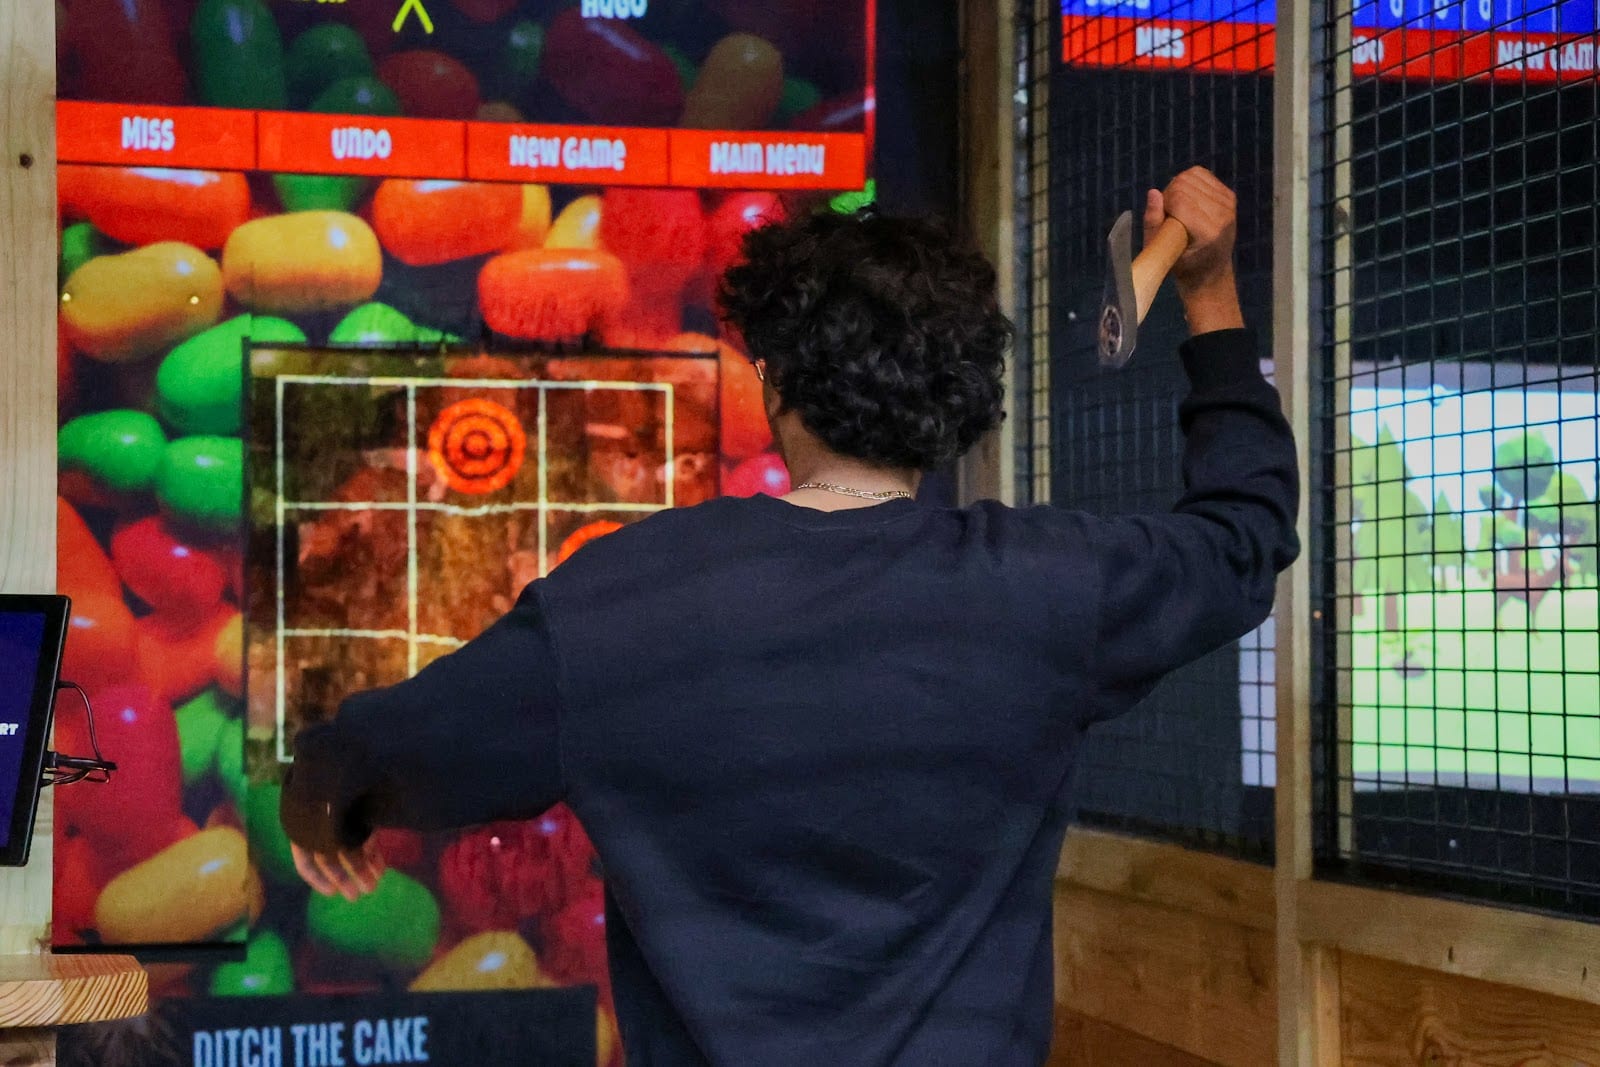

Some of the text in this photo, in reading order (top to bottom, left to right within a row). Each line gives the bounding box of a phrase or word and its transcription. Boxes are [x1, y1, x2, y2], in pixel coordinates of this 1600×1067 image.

[1135, 26, 1185, 58] MISS
[1549, 43, 1600, 71] GAM
[121, 116, 175, 151] MISS
[331, 127, 392, 160] UNDO
[193, 1016, 429, 1067] DITCH THE CAKE
